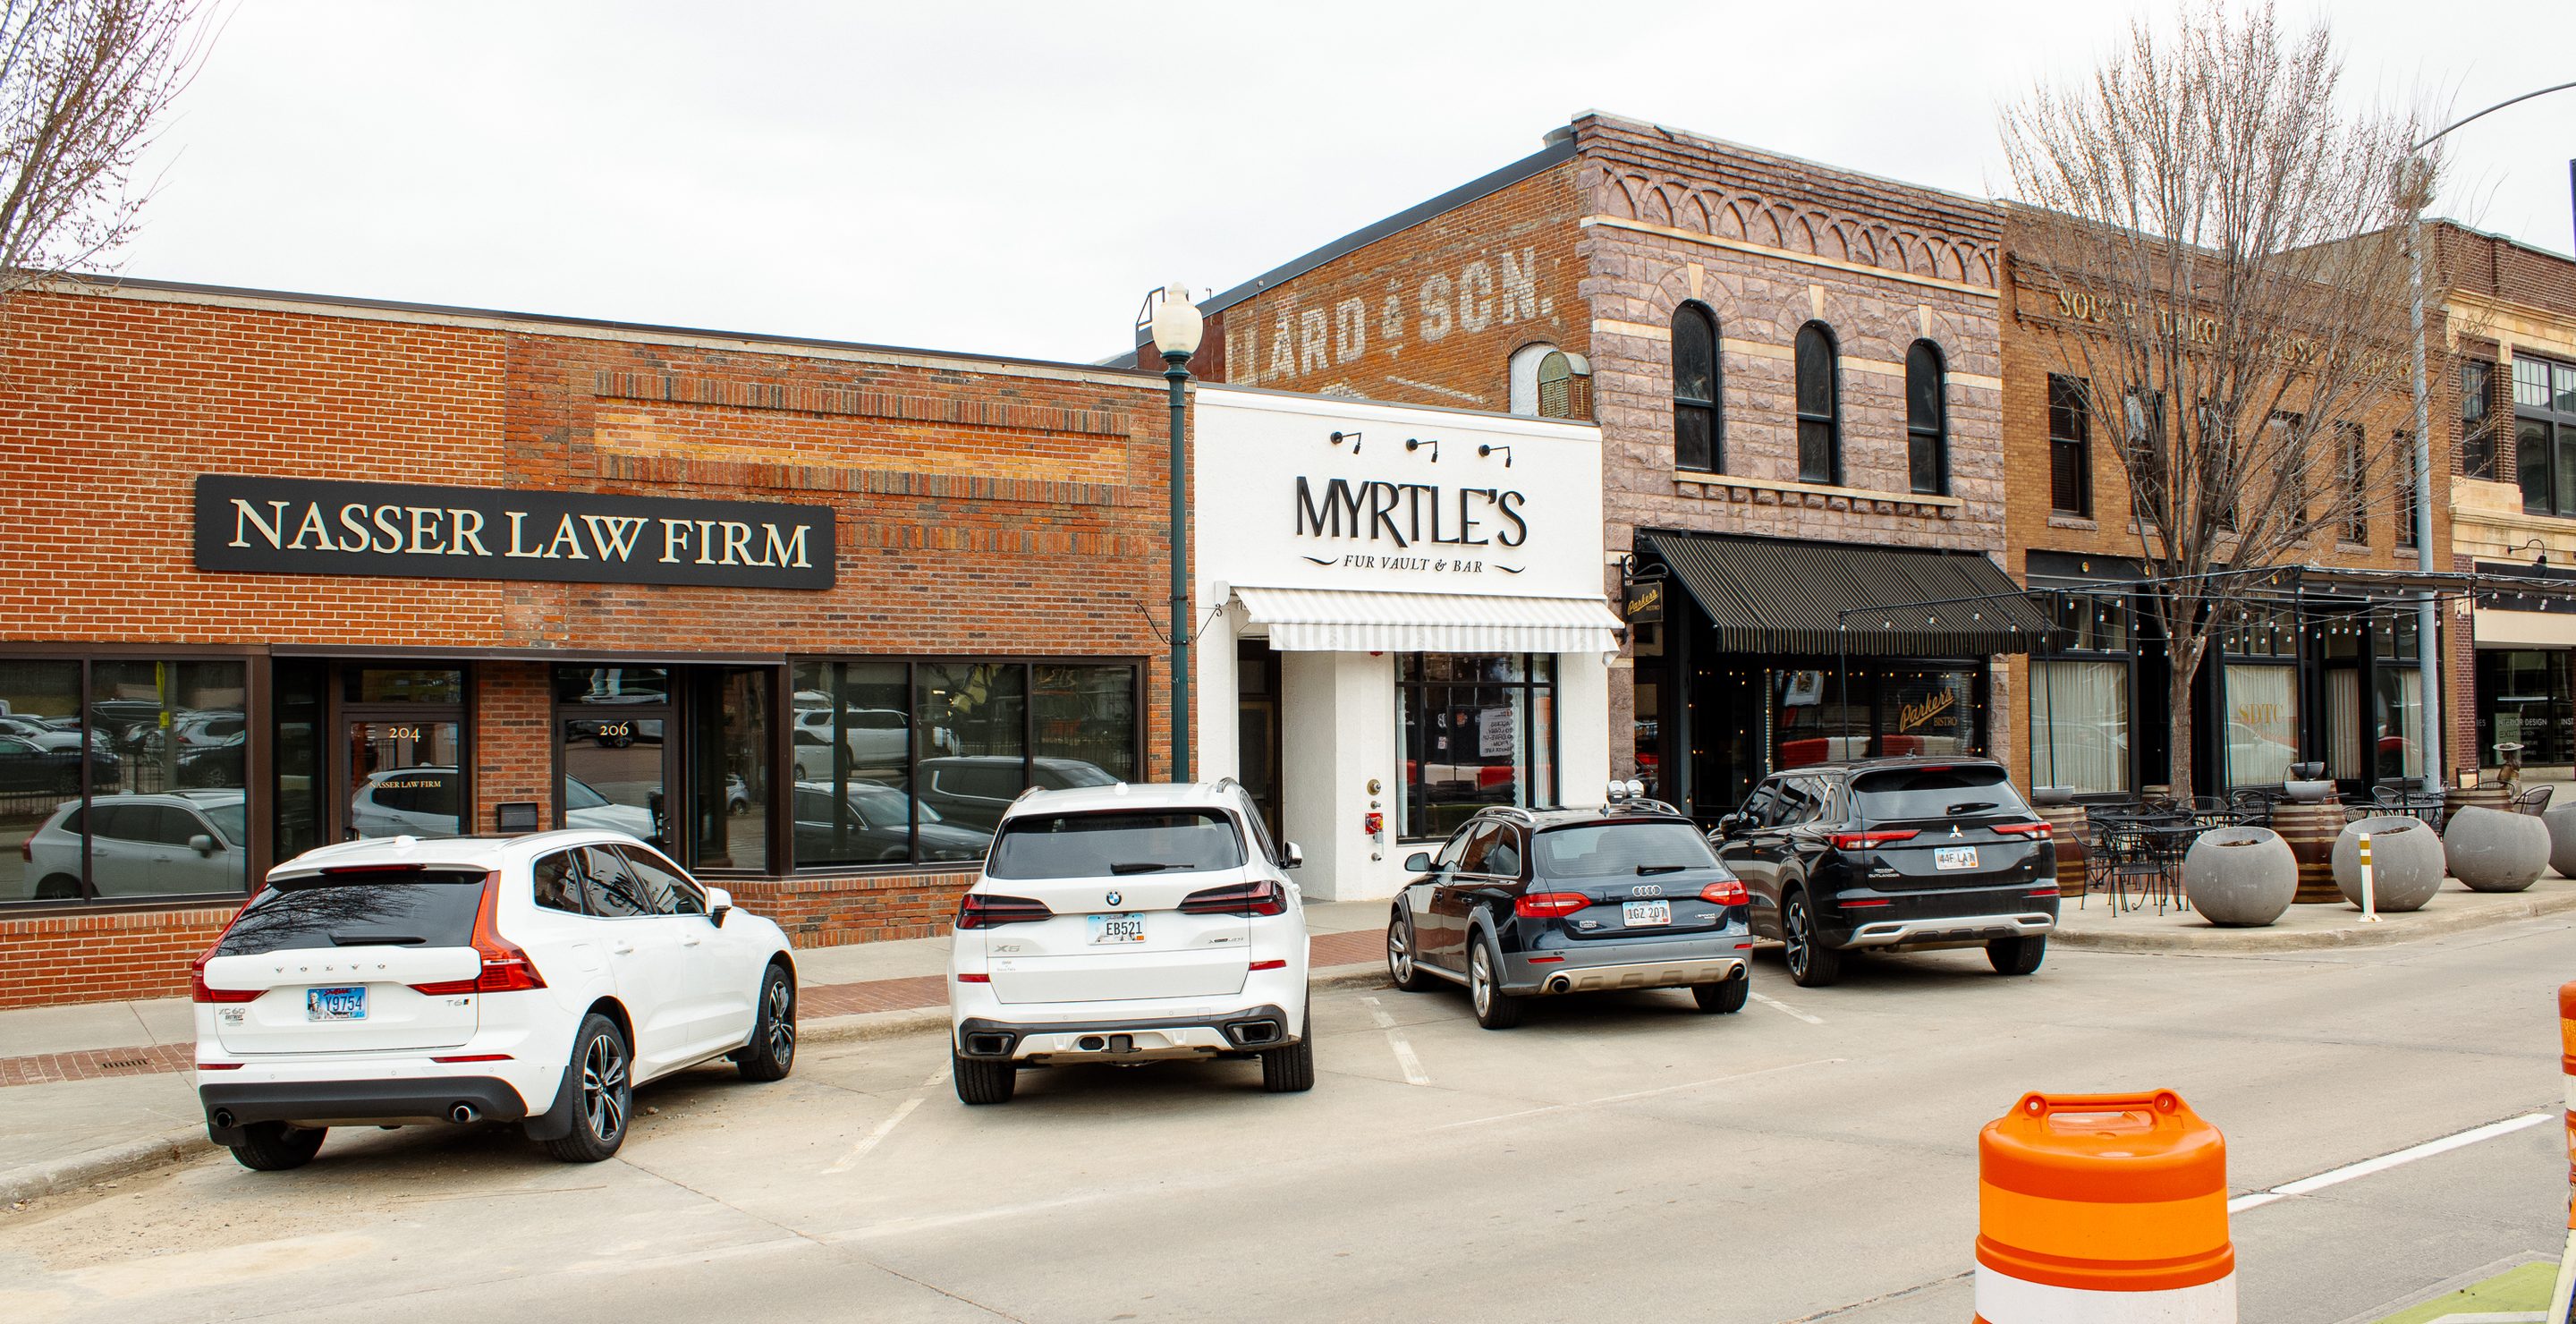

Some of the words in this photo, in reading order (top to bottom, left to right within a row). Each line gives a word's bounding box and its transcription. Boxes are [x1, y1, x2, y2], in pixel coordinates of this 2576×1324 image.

[2059, 290, 2138, 330] SOUH
[1296, 476, 1527, 547] MYRTLE'S
[228, 498, 492, 556] NASSER
[504, 511, 648, 562] LAW
[658, 518, 812, 568] FIRM
[1343, 555, 1375, 568] FUR
[1381, 556, 1429, 571] VAULT
[1435, 558, 1447, 573] &
[1453, 560, 1483, 573] BAR
[1900, 686, 1955, 734] Parker's
[2239, 703, 2283, 725] SDTC
[600, 722, 629, 736] 206
[1933, 717, 1958, 726] BISTRO
[2524, 717, 2547, 726] DESIGN
[389, 727, 421, 743] 204
[369, 781, 400, 789] NASSER
[420, 780, 441, 788] FIRM
[1628, 908, 1645, 919] 1GZ
[1648, 906, 1665, 918] 207
[1106, 921, 1142, 936] EB521
[275, 963, 387, 973] VOLVO
[326, 995, 362, 1011] Y9754
